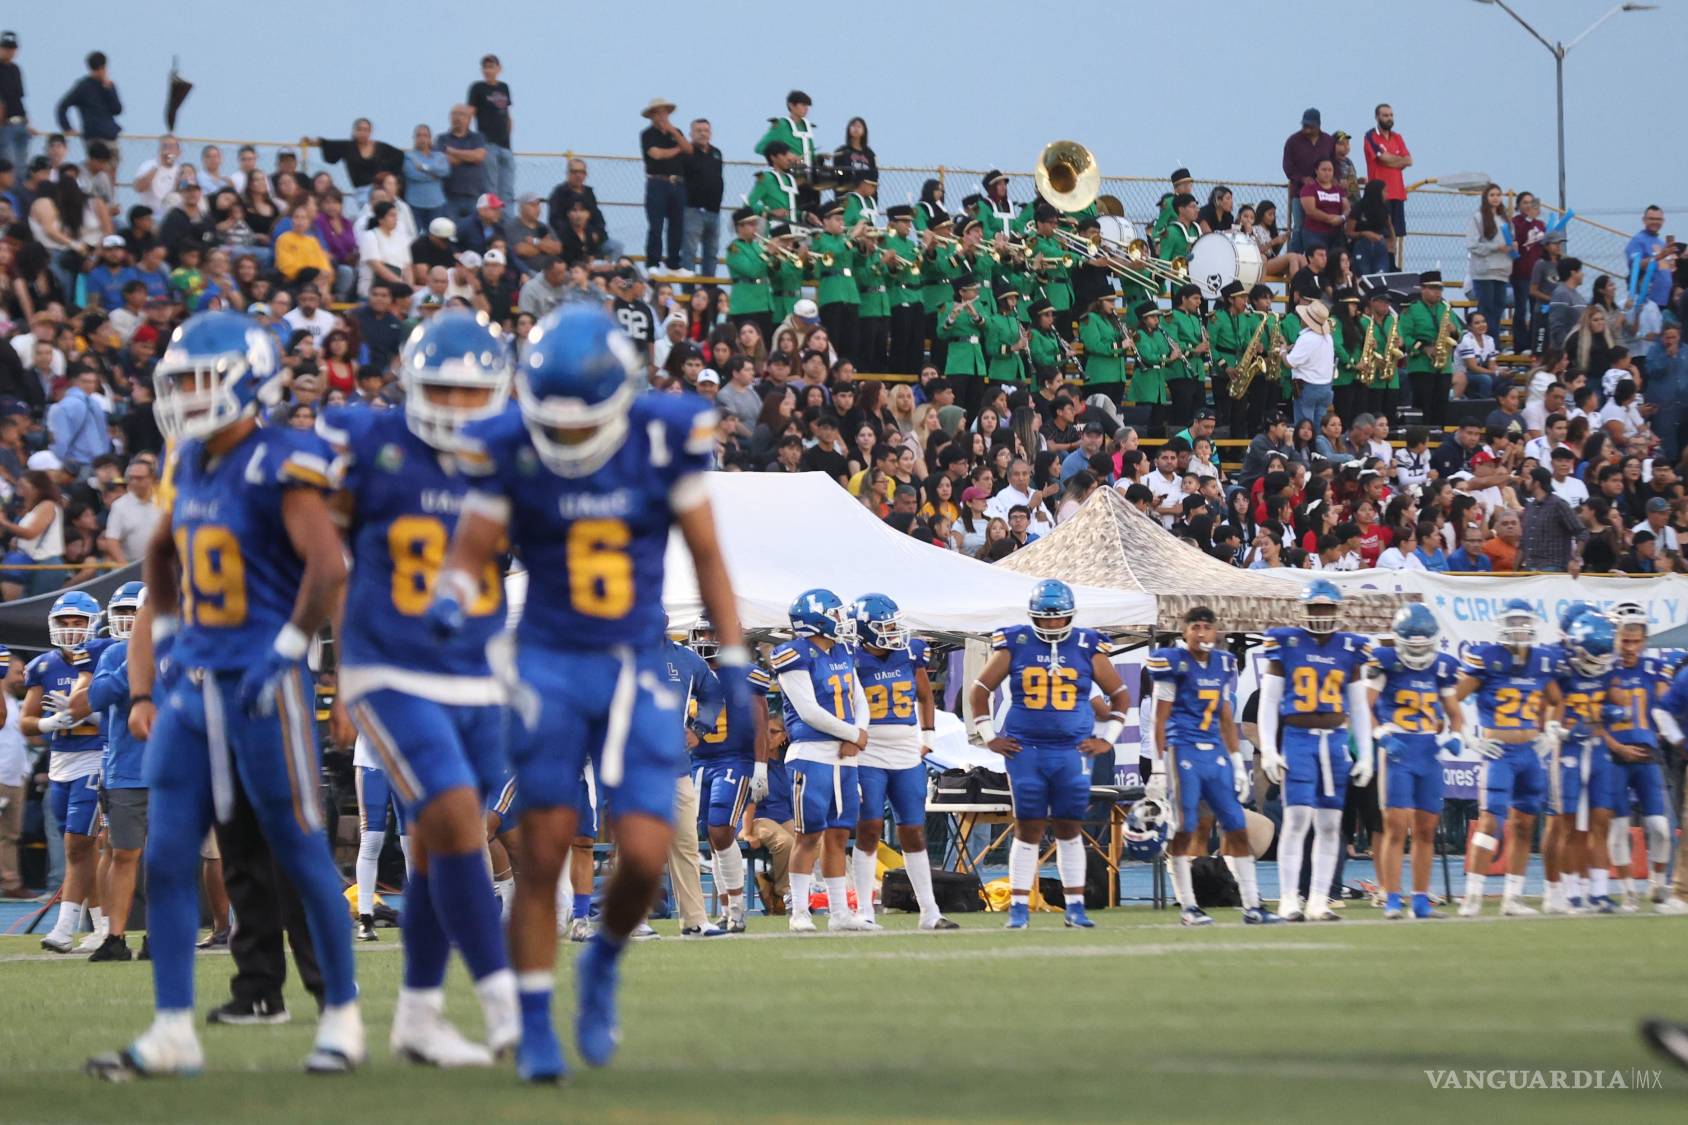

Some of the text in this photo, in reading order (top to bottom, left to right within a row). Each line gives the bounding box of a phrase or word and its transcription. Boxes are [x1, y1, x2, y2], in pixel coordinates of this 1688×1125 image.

[566, 517, 635, 620] 6
[865, 681, 912, 719] 95
[1022, 667, 1078, 710] 96
[1293, 666, 1345, 712] 94
[1198, 690, 1220, 731] 7
[1393, 690, 1438, 732] 25
